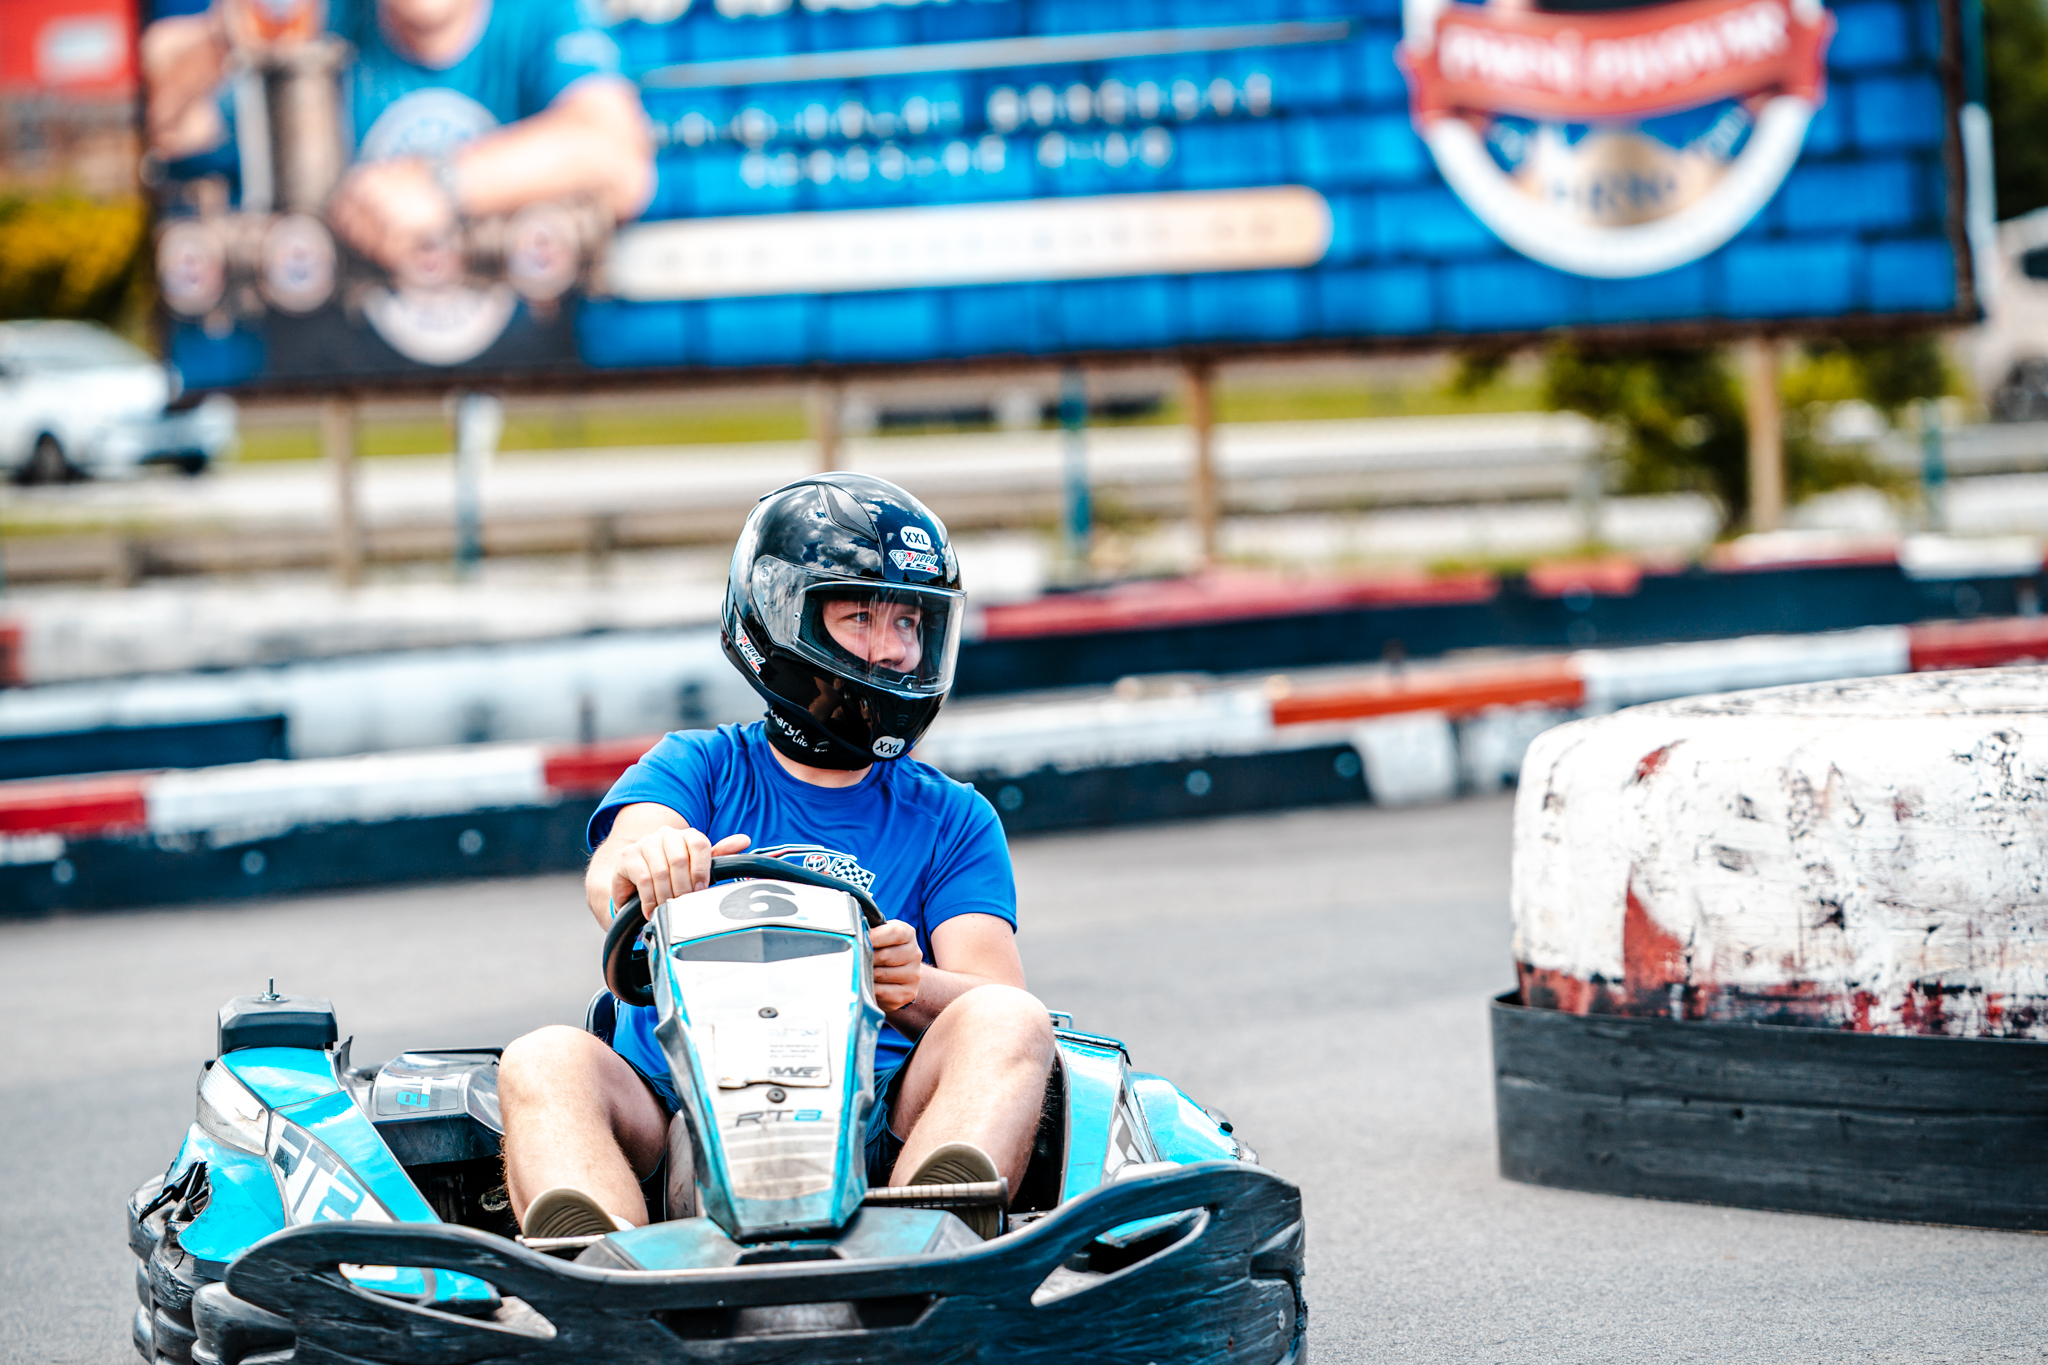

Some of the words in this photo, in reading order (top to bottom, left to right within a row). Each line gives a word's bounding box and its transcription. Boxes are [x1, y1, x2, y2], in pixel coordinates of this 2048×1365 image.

[903, 531, 929, 546] XXL
[875, 740, 900, 754] XXL
[719, 883, 799, 921] 6
[735, 1109, 823, 1128] RT8
